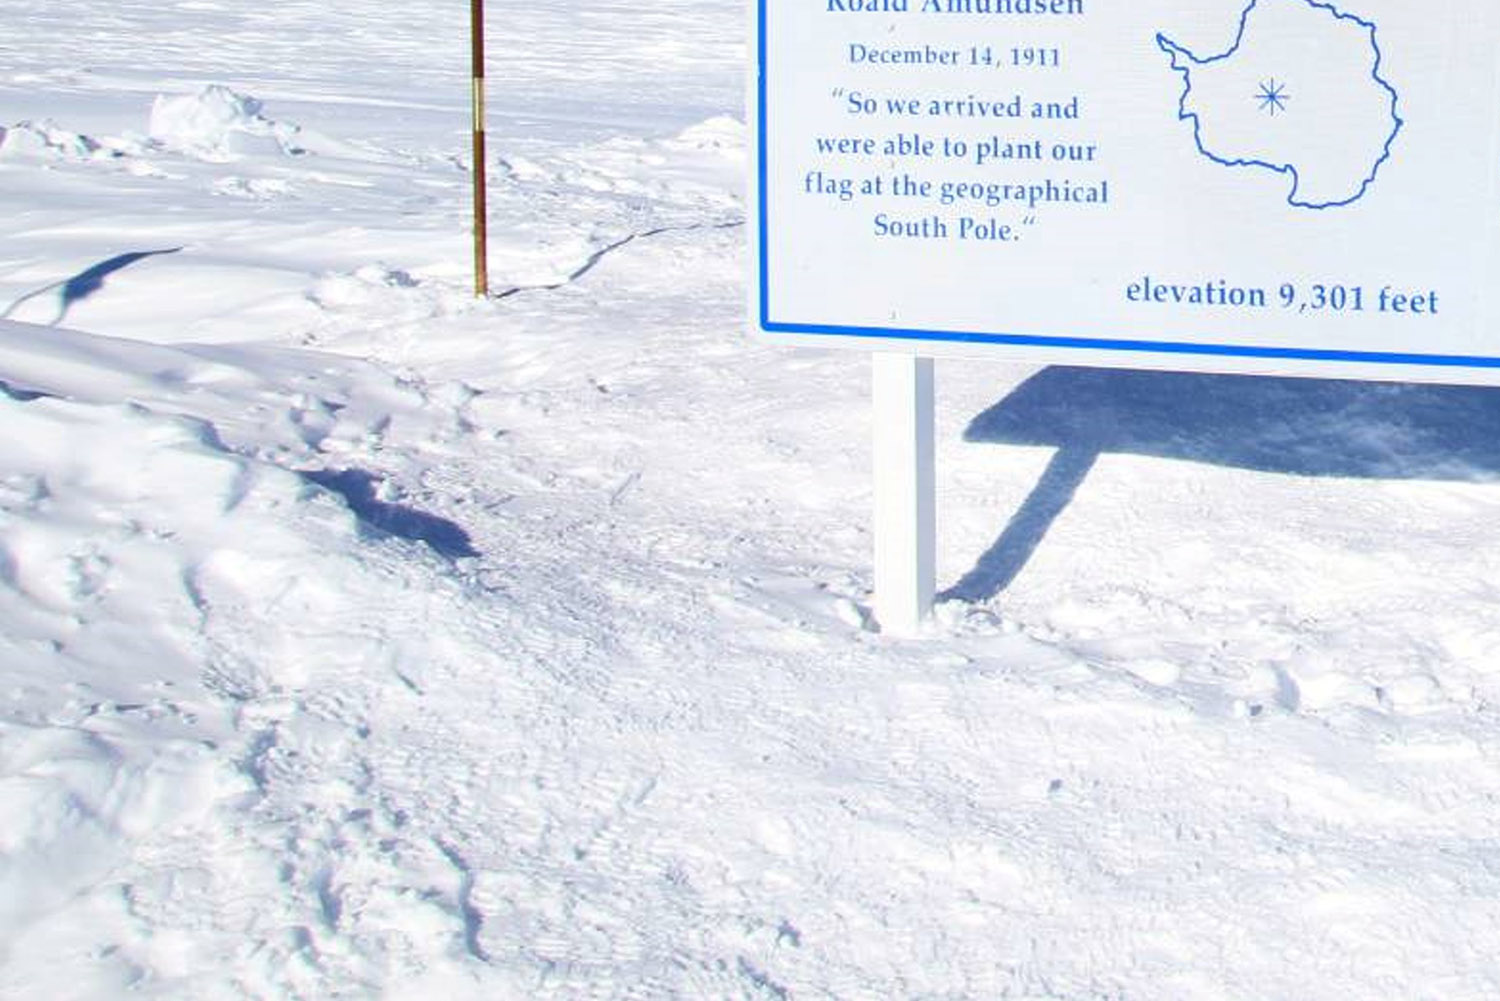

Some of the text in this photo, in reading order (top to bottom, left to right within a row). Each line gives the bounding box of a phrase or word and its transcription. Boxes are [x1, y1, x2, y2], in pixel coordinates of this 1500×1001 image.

[849, 43, 1059, 68] December 14, 1911
[886, 99, 921, 116] we
[928, 95, 1021, 118] arrived
[1031, 96, 1079, 120] and
[816, 133, 1097, 166] were able to plant our
[805, 171, 1108, 209] flag at the geographical
[873, 213, 947, 238] South
[1126, 275, 1439, 315] elevation 9,301 feet
